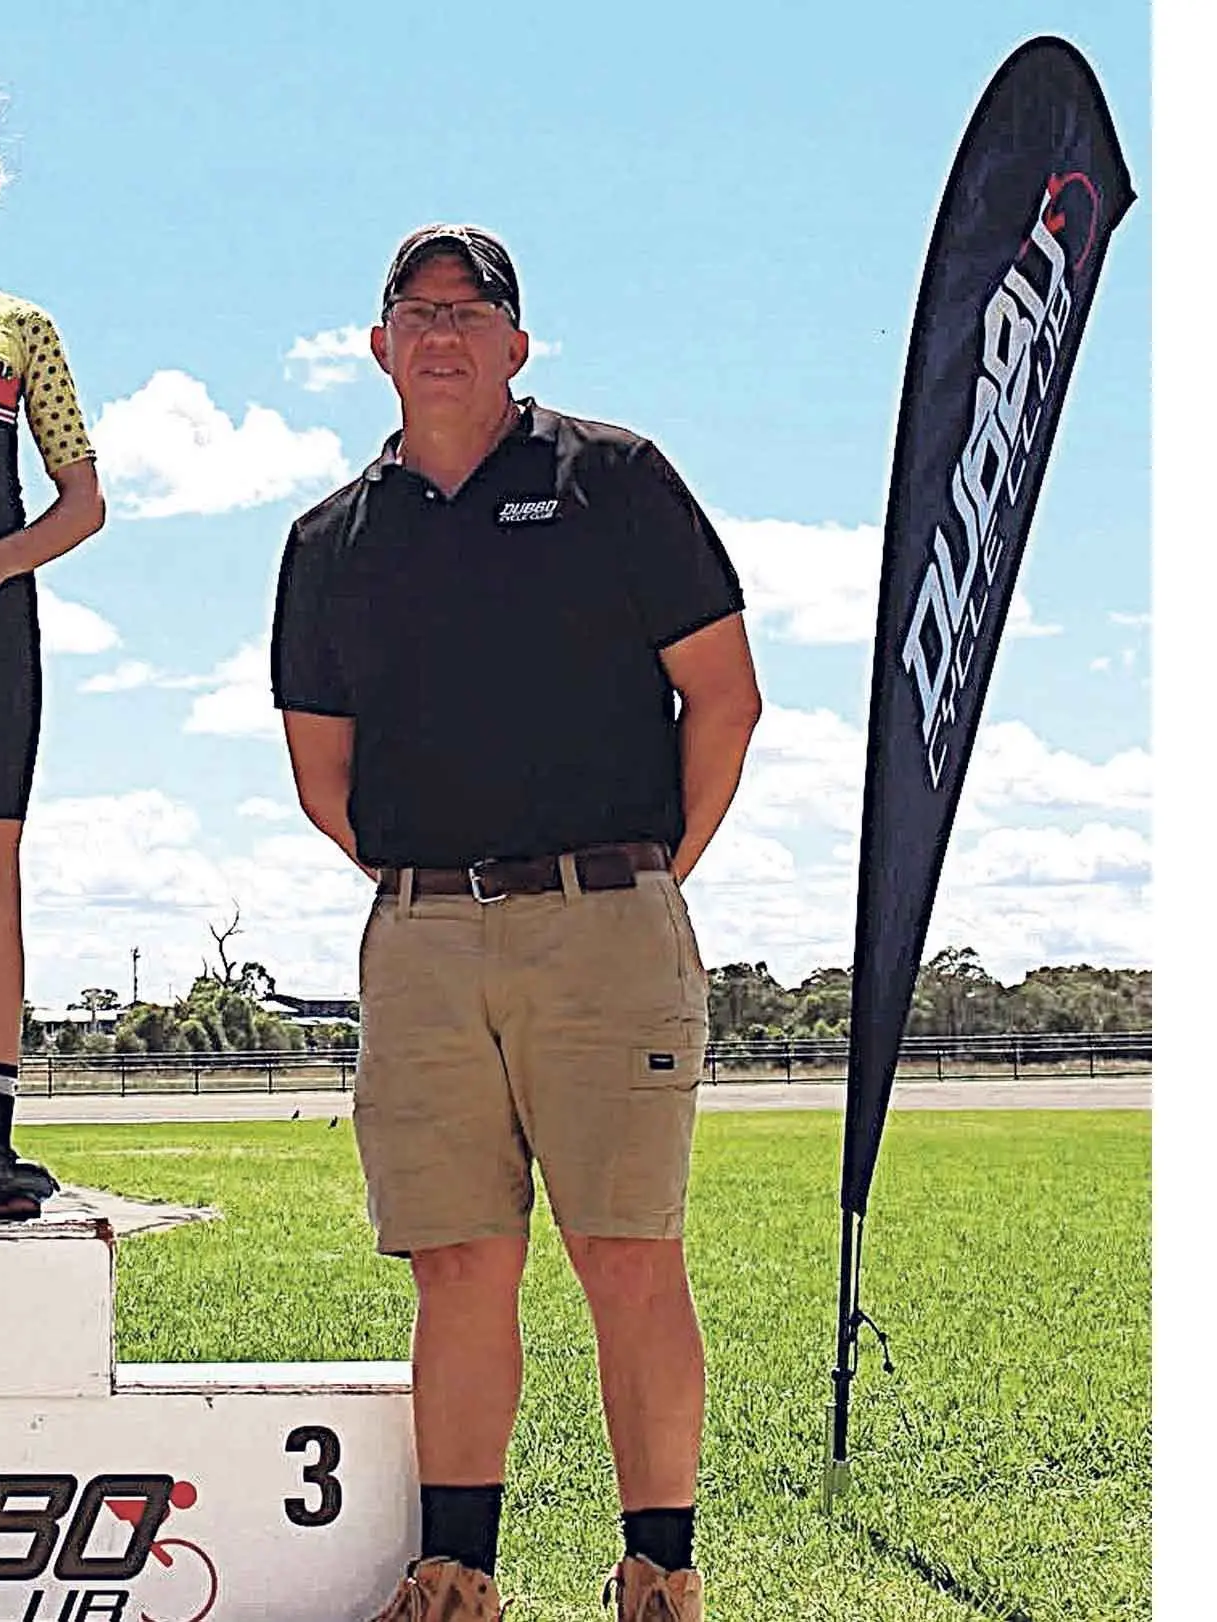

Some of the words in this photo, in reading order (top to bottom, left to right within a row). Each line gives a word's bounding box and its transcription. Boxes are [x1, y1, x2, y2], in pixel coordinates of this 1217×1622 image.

[928, 512, 1004, 790] CYCLE
[1007, 276, 1072, 507] CLUB
[284, 1425, 342, 1527] 3
